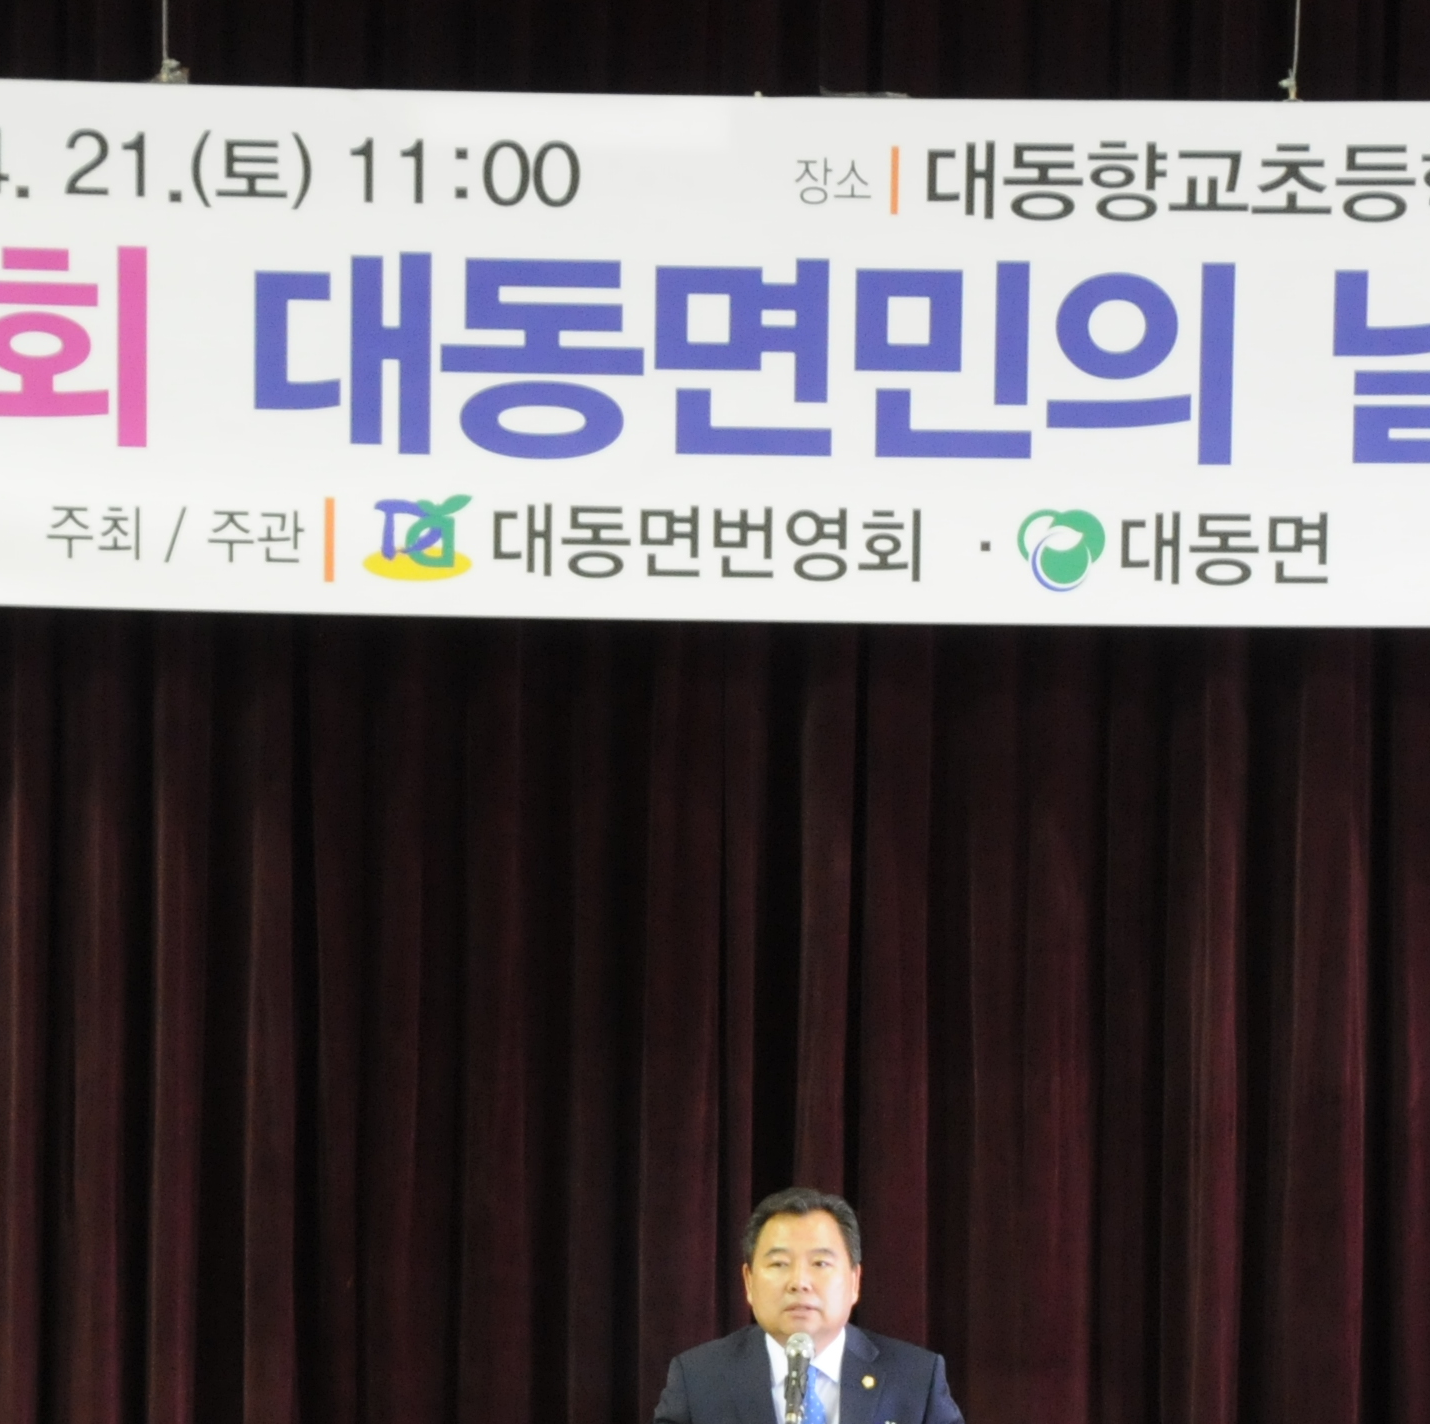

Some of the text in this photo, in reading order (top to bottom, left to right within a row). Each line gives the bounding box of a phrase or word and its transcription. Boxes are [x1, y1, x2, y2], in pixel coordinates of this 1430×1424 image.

[351, 138, 580, 207] 11:00
[795, 158, 871, 205] 장소
[254, 252, 1235, 465] 대동면민의
[47, 506, 140, 560] 주최
[208, 511, 304, 563] 주관
[493, 504, 921, 582] 대동면번영회
[1121, 512, 1328, 586] 대동면
